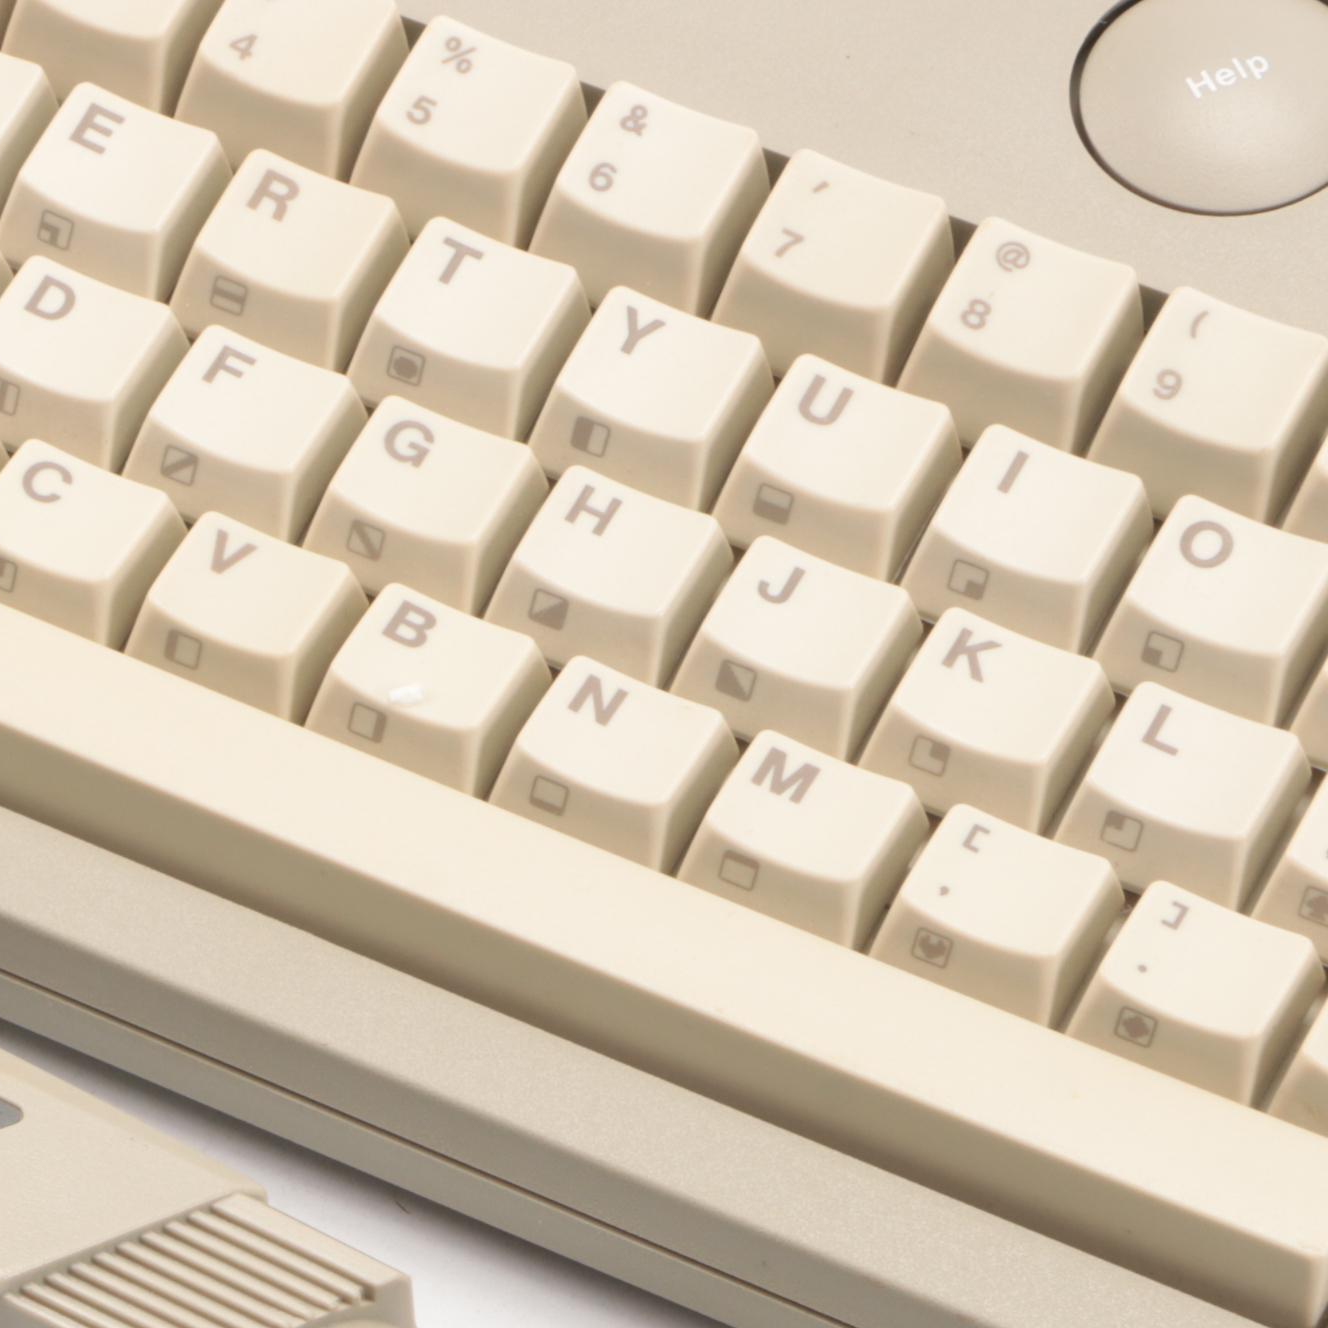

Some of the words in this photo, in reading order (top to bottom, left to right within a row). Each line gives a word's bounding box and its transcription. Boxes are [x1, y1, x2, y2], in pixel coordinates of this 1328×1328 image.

[229, 33, 258, 60] 4
[442, 36, 474, 75] %
[1185, 51, 1270, 99] Help
[68, 102, 125, 154] E
[406, 96, 438, 126] 5
[620, 105, 648, 137] &
[245, 168, 301, 223] R
[588, 161, 618, 193] 6
[436, 236, 483, 287] T
[774, 228, 805, 259] 7
[995, 240, 1031, 274] @
[23, 275, 77, 322] D
[959, 298, 993, 331] 8
[616, 305, 666, 356] Y
[1189, 309, 1210, 340] (
[201, 344, 256, 386] F
[1152, 367, 1184, 401] 9
[797, 373, 856, 427] U
[382, 418, 436, 470] G
[21, 460, 74, 504] C
[996, 450, 1031, 494] I
[562, 483, 624, 537] H
[206, 528, 257, 575] V
[1178, 519, 1234, 569] O
[756, 565, 806, 605] J
[380, 598, 438, 650] B
[940, 627, 1003, 684] K
[566, 673, 630, 728] N
[1140, 703, 1180, 757] L
[749, 746, 821, 805] M
[961, 822, 991, 854] [
[1160, 900, 1190, 931] ]
